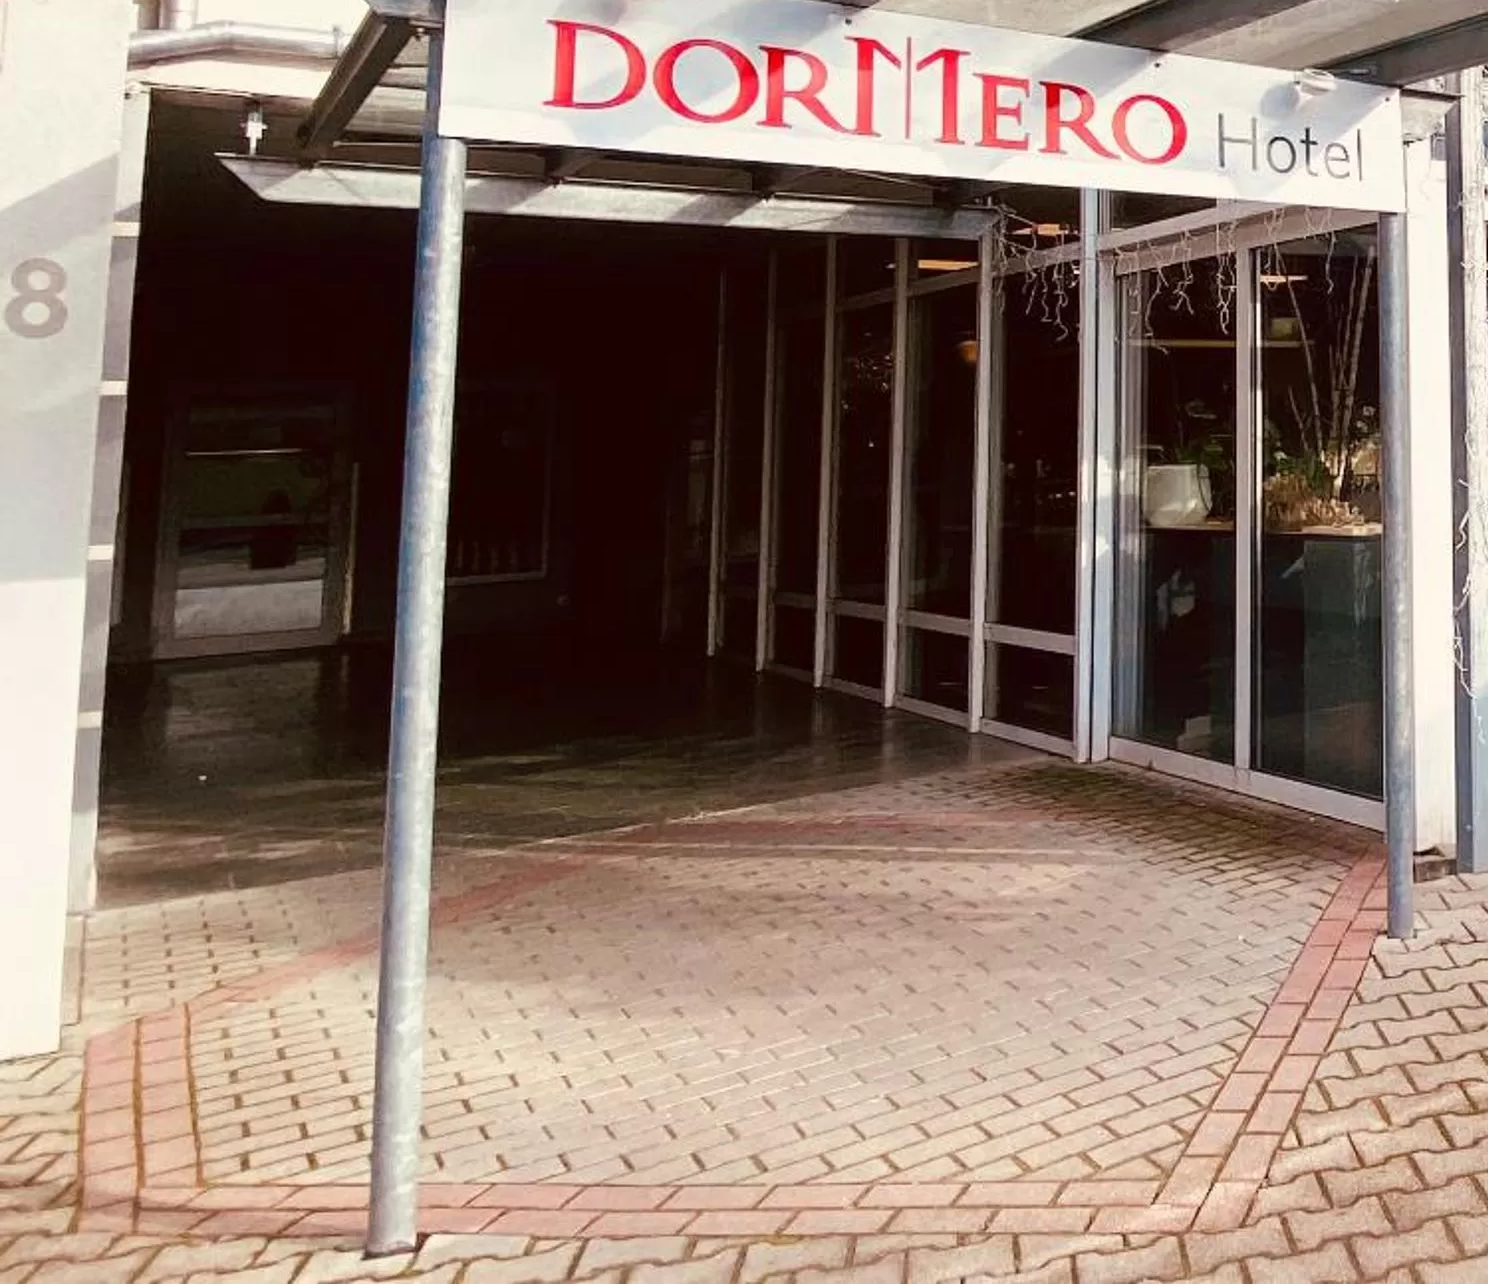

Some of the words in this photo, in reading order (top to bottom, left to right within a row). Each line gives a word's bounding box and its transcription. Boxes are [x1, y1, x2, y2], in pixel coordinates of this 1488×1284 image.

[543, 20, 1188, 166] DORMERO
[1217, 112, 1363, 182] Hotel
[4, 257, 68, 340] 8
